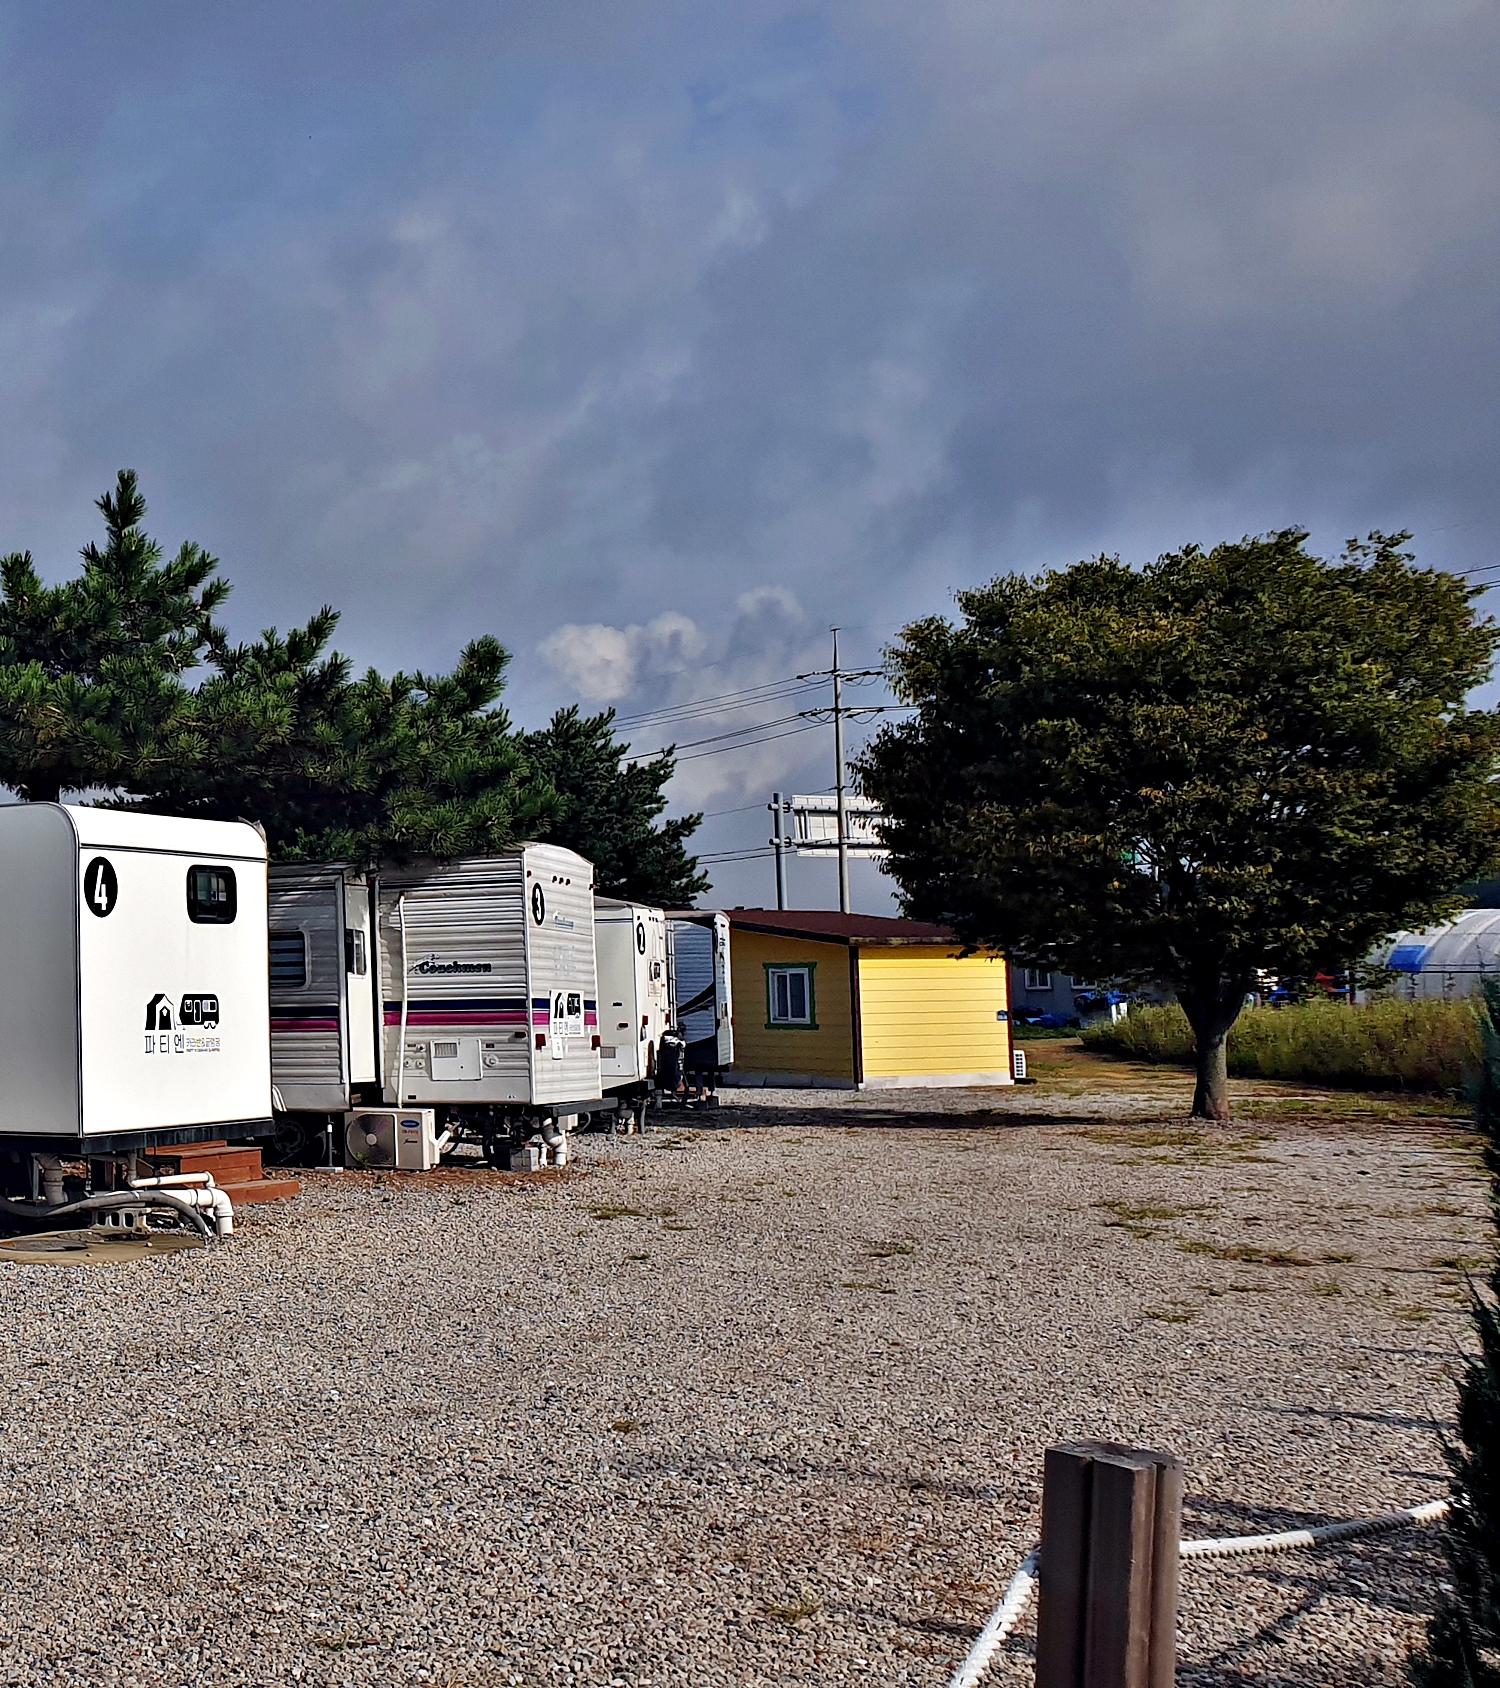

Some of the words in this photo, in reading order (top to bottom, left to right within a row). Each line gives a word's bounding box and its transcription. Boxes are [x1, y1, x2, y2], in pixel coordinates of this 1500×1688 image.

[94, 864, 108, 911] 4
[535, 887, 542, 921] 3
[418, 960, 492, 974] Coachmen
